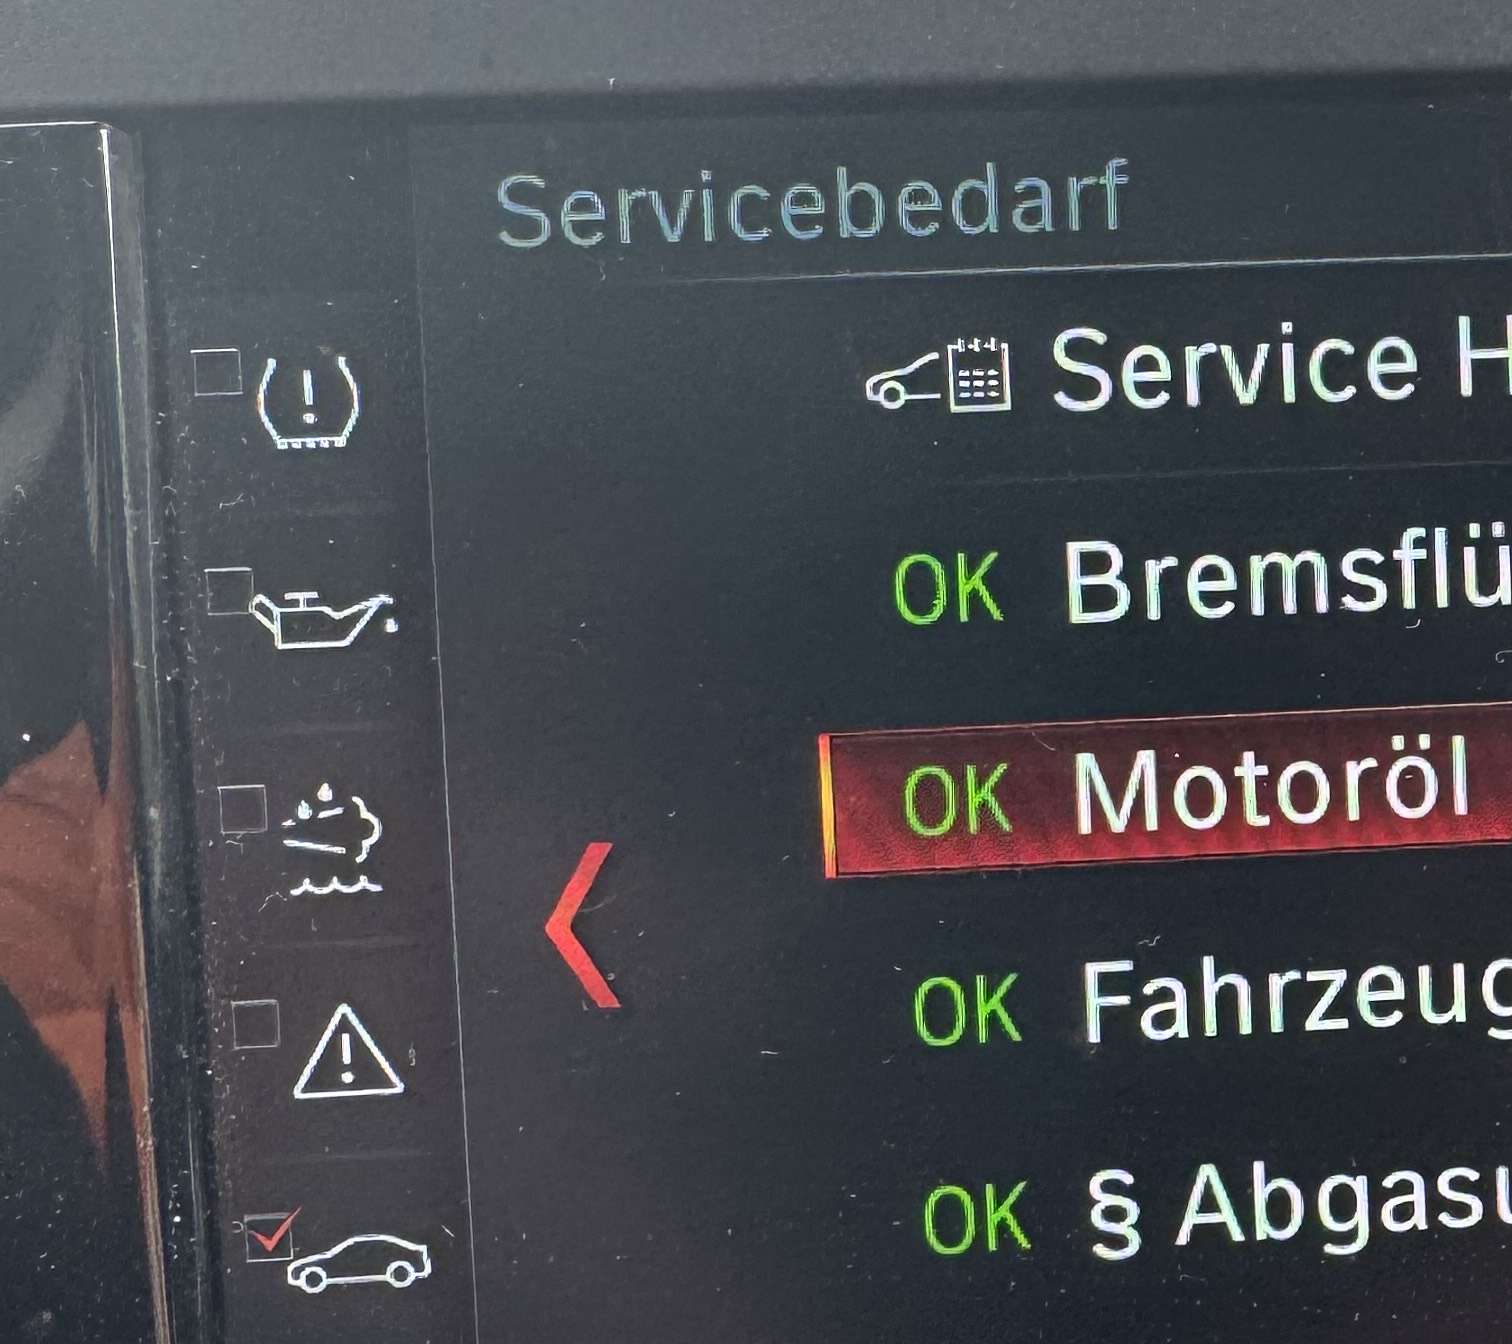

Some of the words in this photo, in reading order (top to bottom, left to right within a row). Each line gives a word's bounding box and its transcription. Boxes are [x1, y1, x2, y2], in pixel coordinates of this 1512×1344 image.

[497, 157, 1130, 249] Servicebedarf
[1052, 321, 1418, 412] Service
[894, 551, 1004, 626] OK
[902, 763, 1014, 837] OK
[1075, 734, 1469, 836] Motoröl
[914, 972, 1023, 1047] OK
[924, 1180, 1032, 1255] OK
[1088, 1168, 1142, 1261] §
